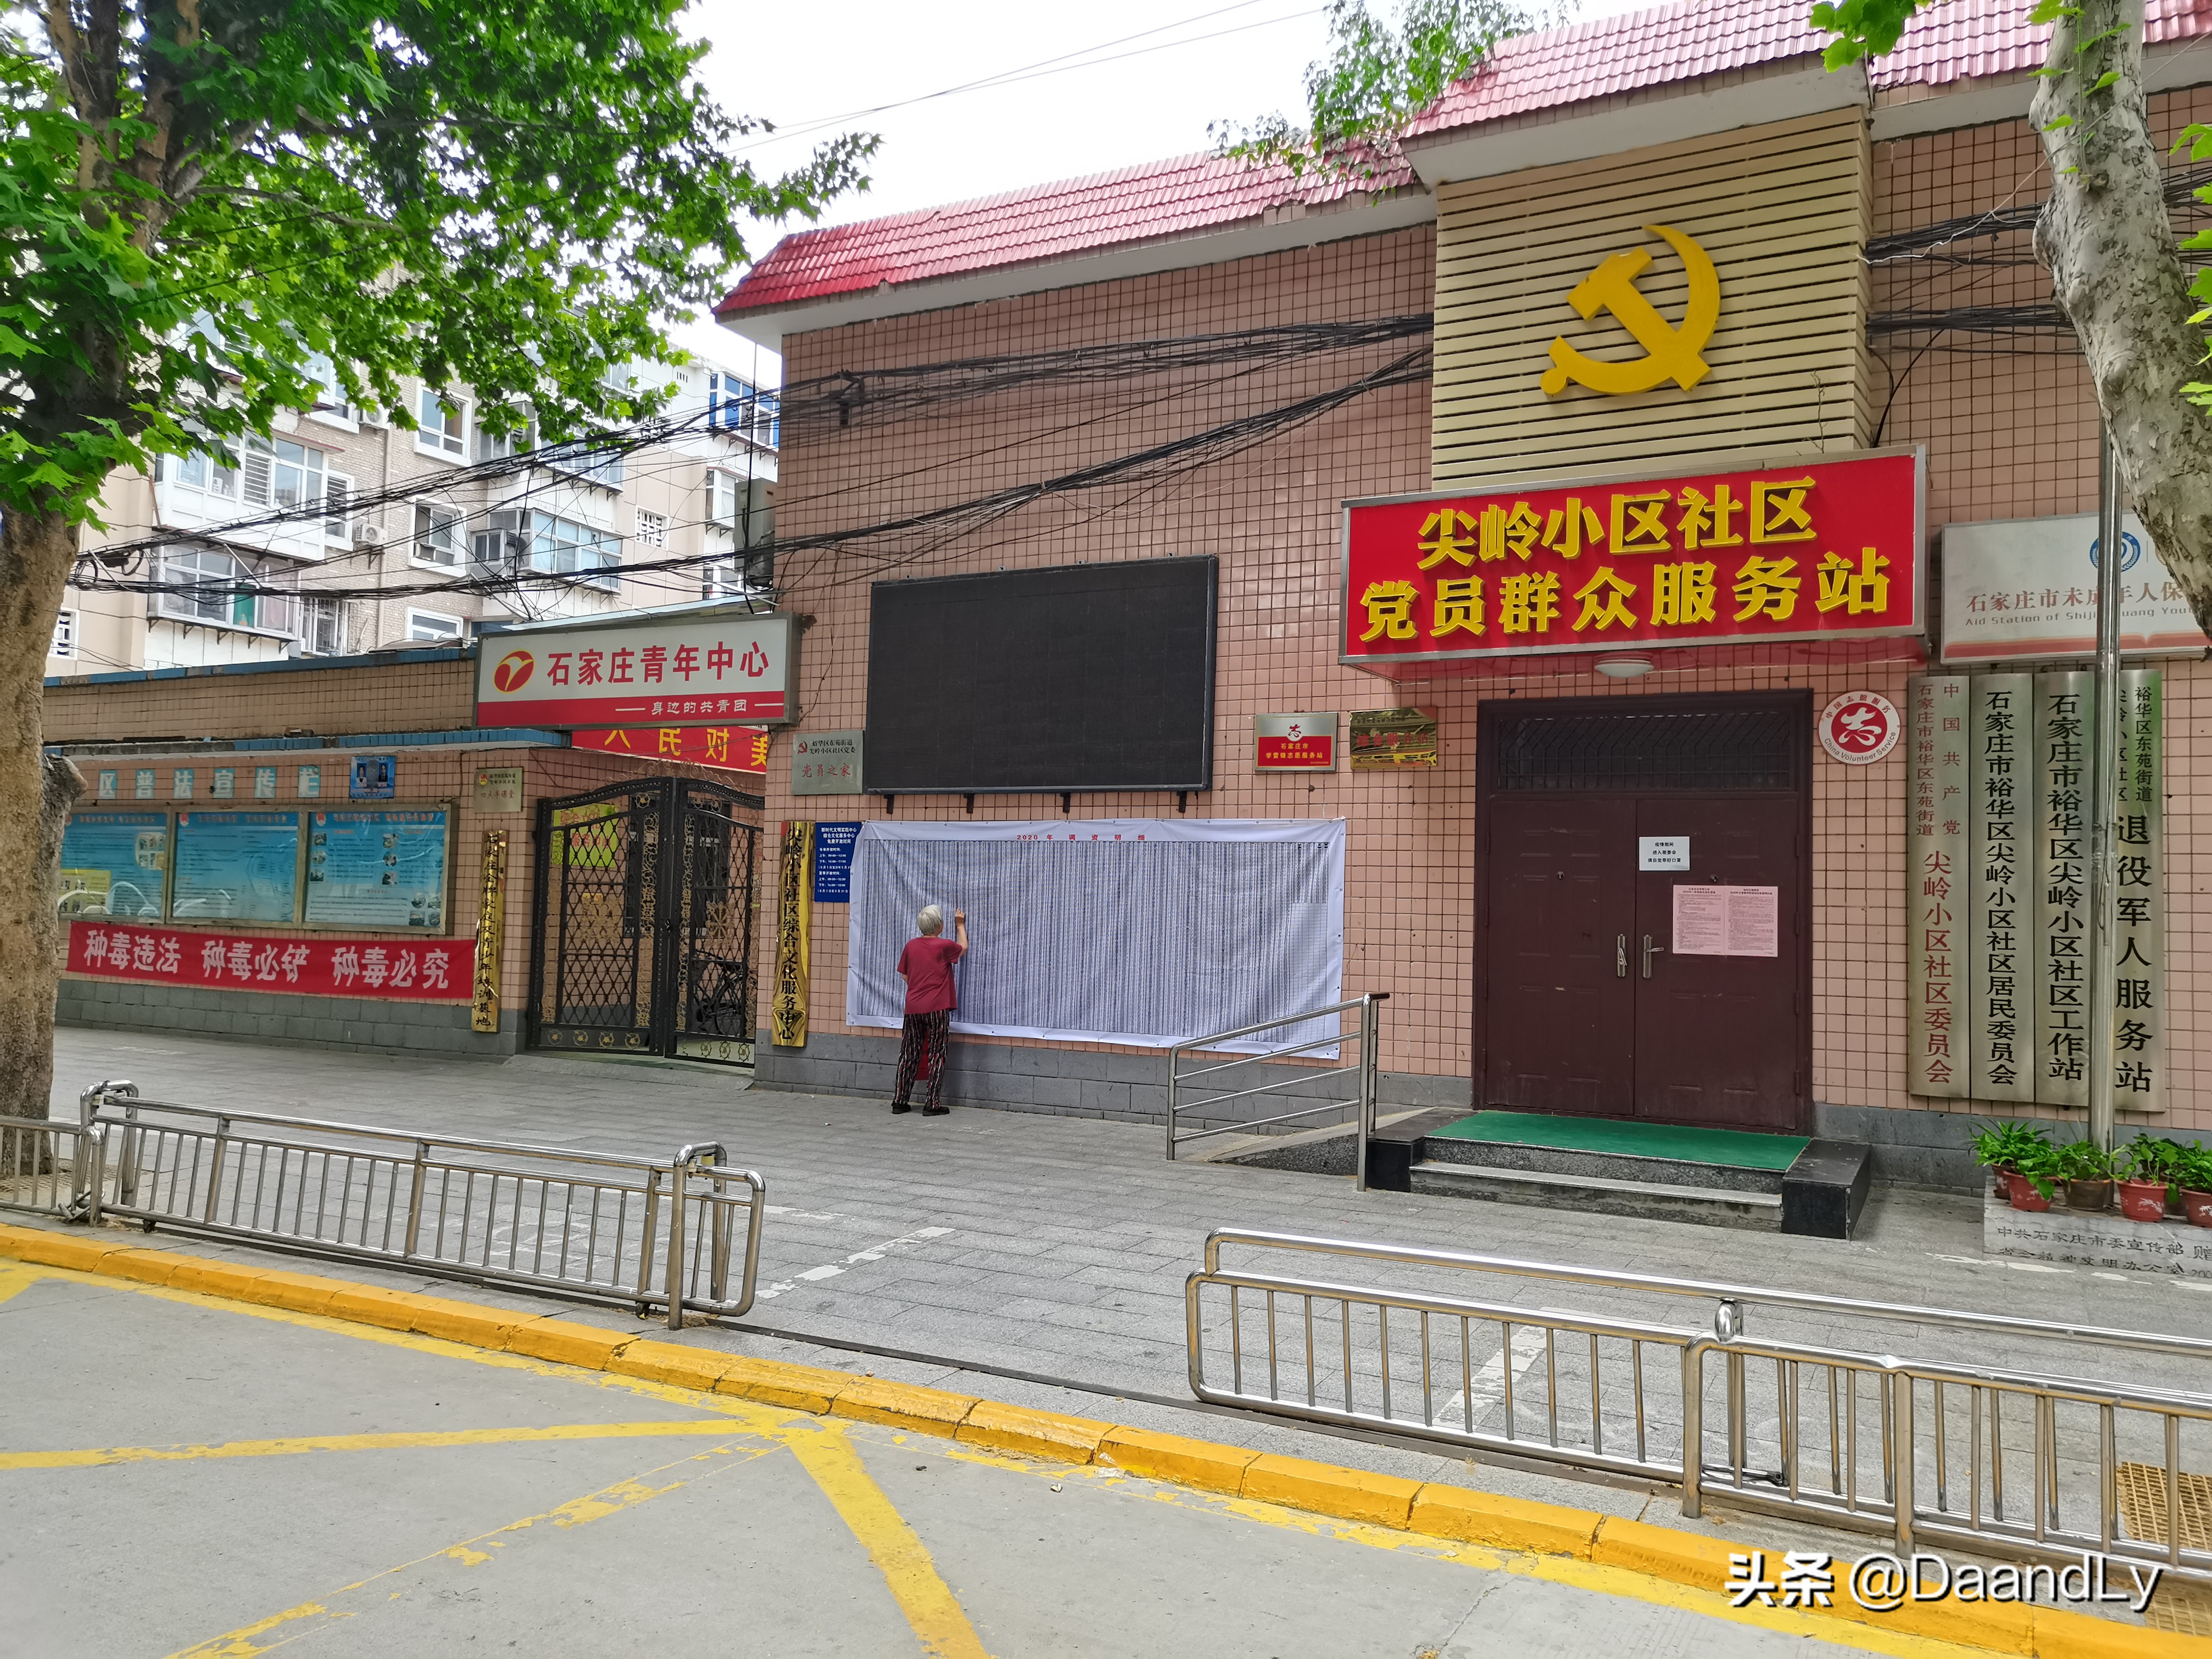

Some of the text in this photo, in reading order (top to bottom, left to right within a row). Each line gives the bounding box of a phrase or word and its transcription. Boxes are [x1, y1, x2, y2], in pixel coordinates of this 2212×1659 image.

[1417, 476, 1817, 570] 尖岭小区社区
[1359, 546, 1891, 643] 党员群众服务站
[1966, 617, 1985, 626] Aid
[1992, 614, 2040, 625] Station
[2046, 613, 2060, 621] of
[547, 641, 769, 686] 石家庄青年中心
[650, 699, 747, 716] 身边的共青团
[812, 739, 853, 747] 裕华区东苑街道
[1357, 732, 1428, 747] 综合服务站
[2135, 686, 2153, 802] 裕华区东苑街道
[99, 767, 319, 799] 区普法宣传栏
[802, 762, 851, 778] 党员之家
[1825, 732, 1896, 762] China Volunteer Service
[1916, 684, 1935, 836] 石家庄市裕华区东苑街道
[1942, 683, 1961, 835] 中国共产党
[1984, 690, 2018, 1086] 石家庄市裕华区尖岭小区社区居民委员会
[2046, 693, 2084, 1081] 石家庄市裕华区尖岭小区社区工作站
[84, 929, 449, 989] 种毒违法 种毒必铲 种毒必究
[778, 827, 802, 1040] 尖岭小区社区综合文化服务中心
[1923, 850, 1953, 1085] 尖岭小区社区委员会
[2115, 815, 2153, 1093] 退役军人服务站
[1997, 1226, 2184, 1255] 中共石家庄市委宣传部
